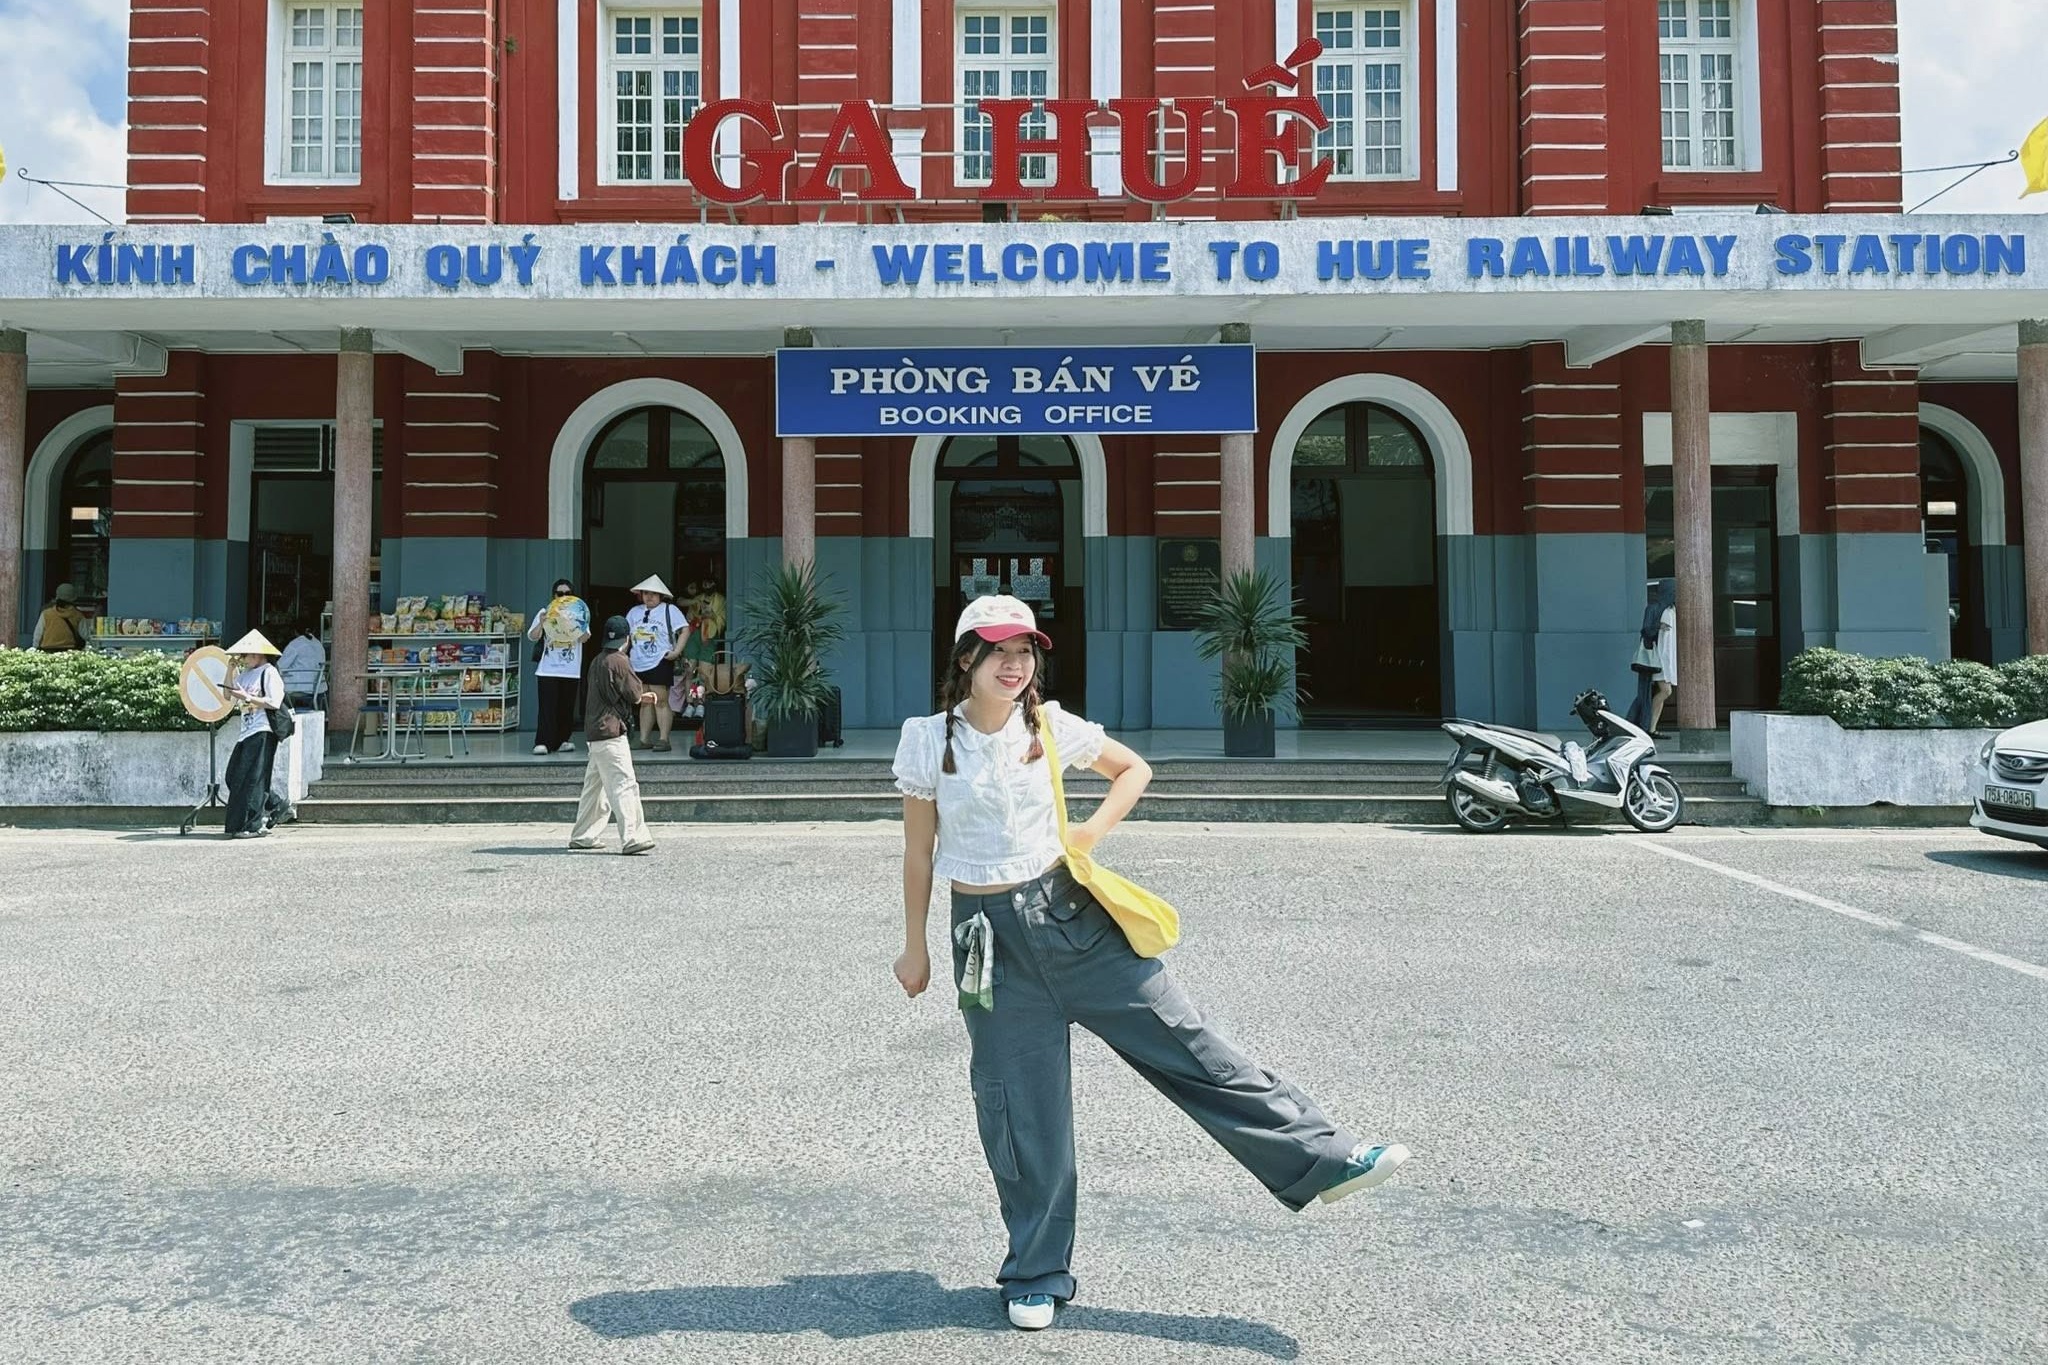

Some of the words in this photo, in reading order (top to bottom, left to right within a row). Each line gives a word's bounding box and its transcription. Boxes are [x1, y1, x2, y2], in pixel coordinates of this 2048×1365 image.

[684, 98, 917, 204] GA
[978, 36, 1334, 204] HUẾ
[57, 231, 196, 284] KÍNH
[231, 232, 391, 285] CHÀO
[425, 233, 543, 287] QUÝ
[579, 234, 777, 285] KHÁCH
[871, 241, 1172, 284] WELCOME
[1208, 241, 1281, 282] TO
[1316, 238, 1431, 280] HUE
[1466, 234, 1738, 277] RAILWAY
[1773, 234, 2026, 275] STATION
[830, 357, 991, 394] PHÒNG
[1011, 355, 1114, 394] BÁN
[1132, 354, 1202, 392] VÉ
[879, 406, 1022, 425] BOOKING
[1044, 405, 1153, 424] OFFICE
